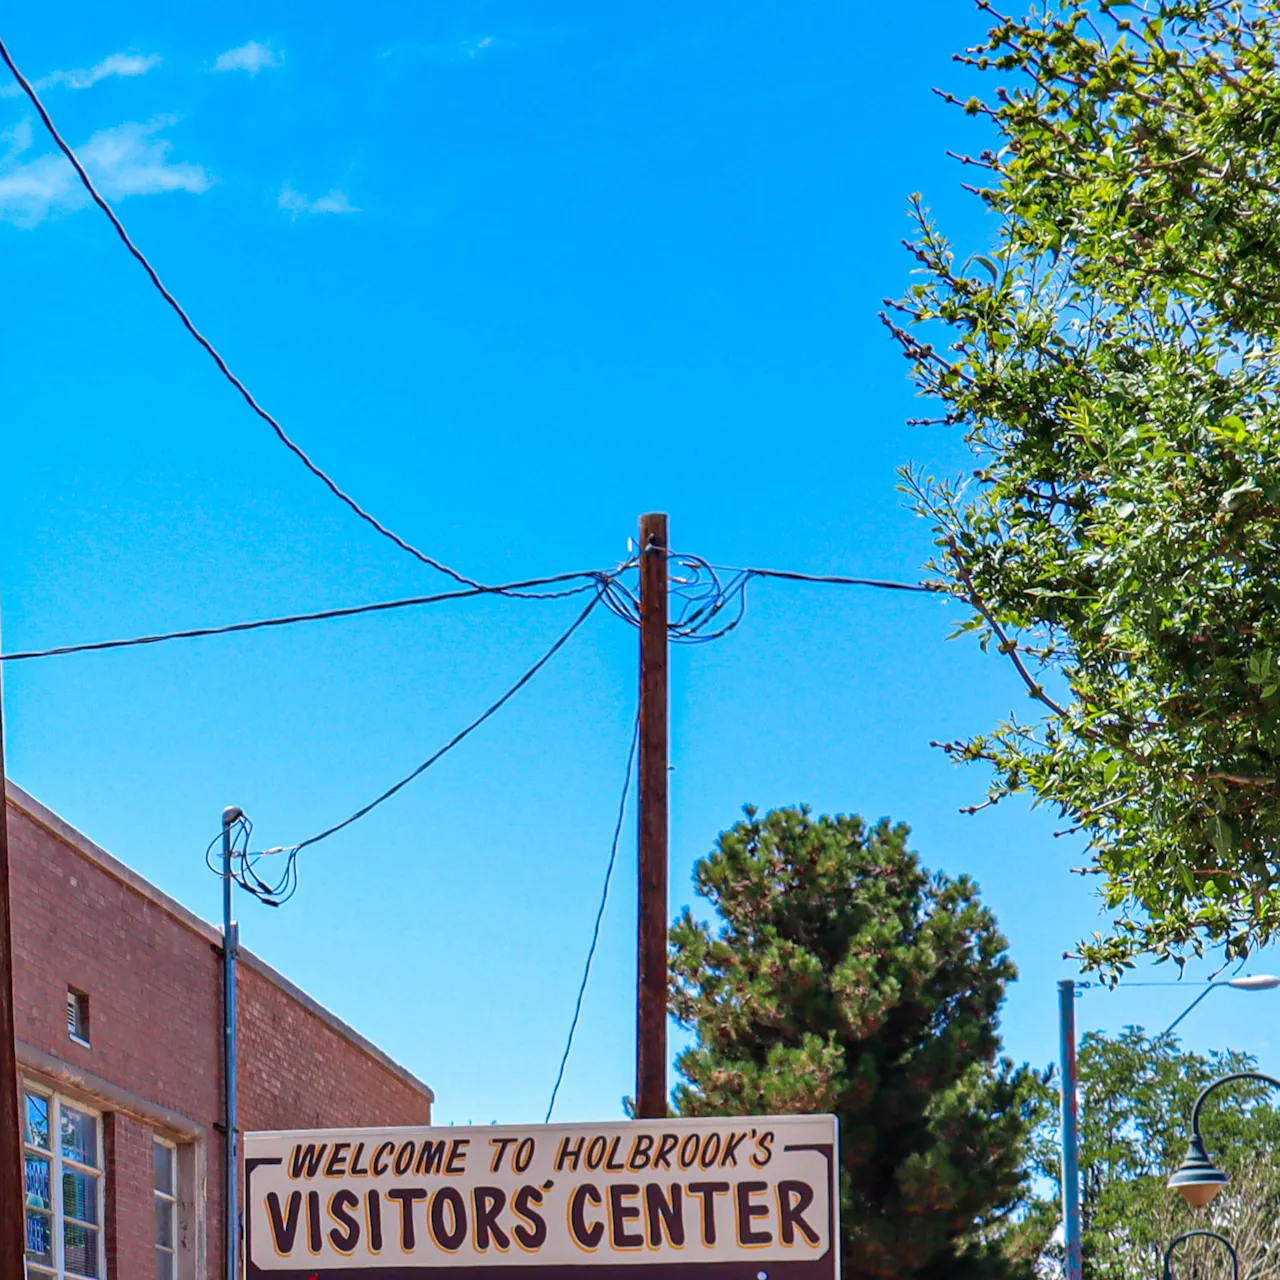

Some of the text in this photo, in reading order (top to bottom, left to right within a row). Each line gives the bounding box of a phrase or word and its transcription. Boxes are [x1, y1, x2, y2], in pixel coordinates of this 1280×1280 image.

[289, 1129, 774, 1178] WELCOME TO HOLBROOK'S
[569, 1180, 821, 1251] CENTER
